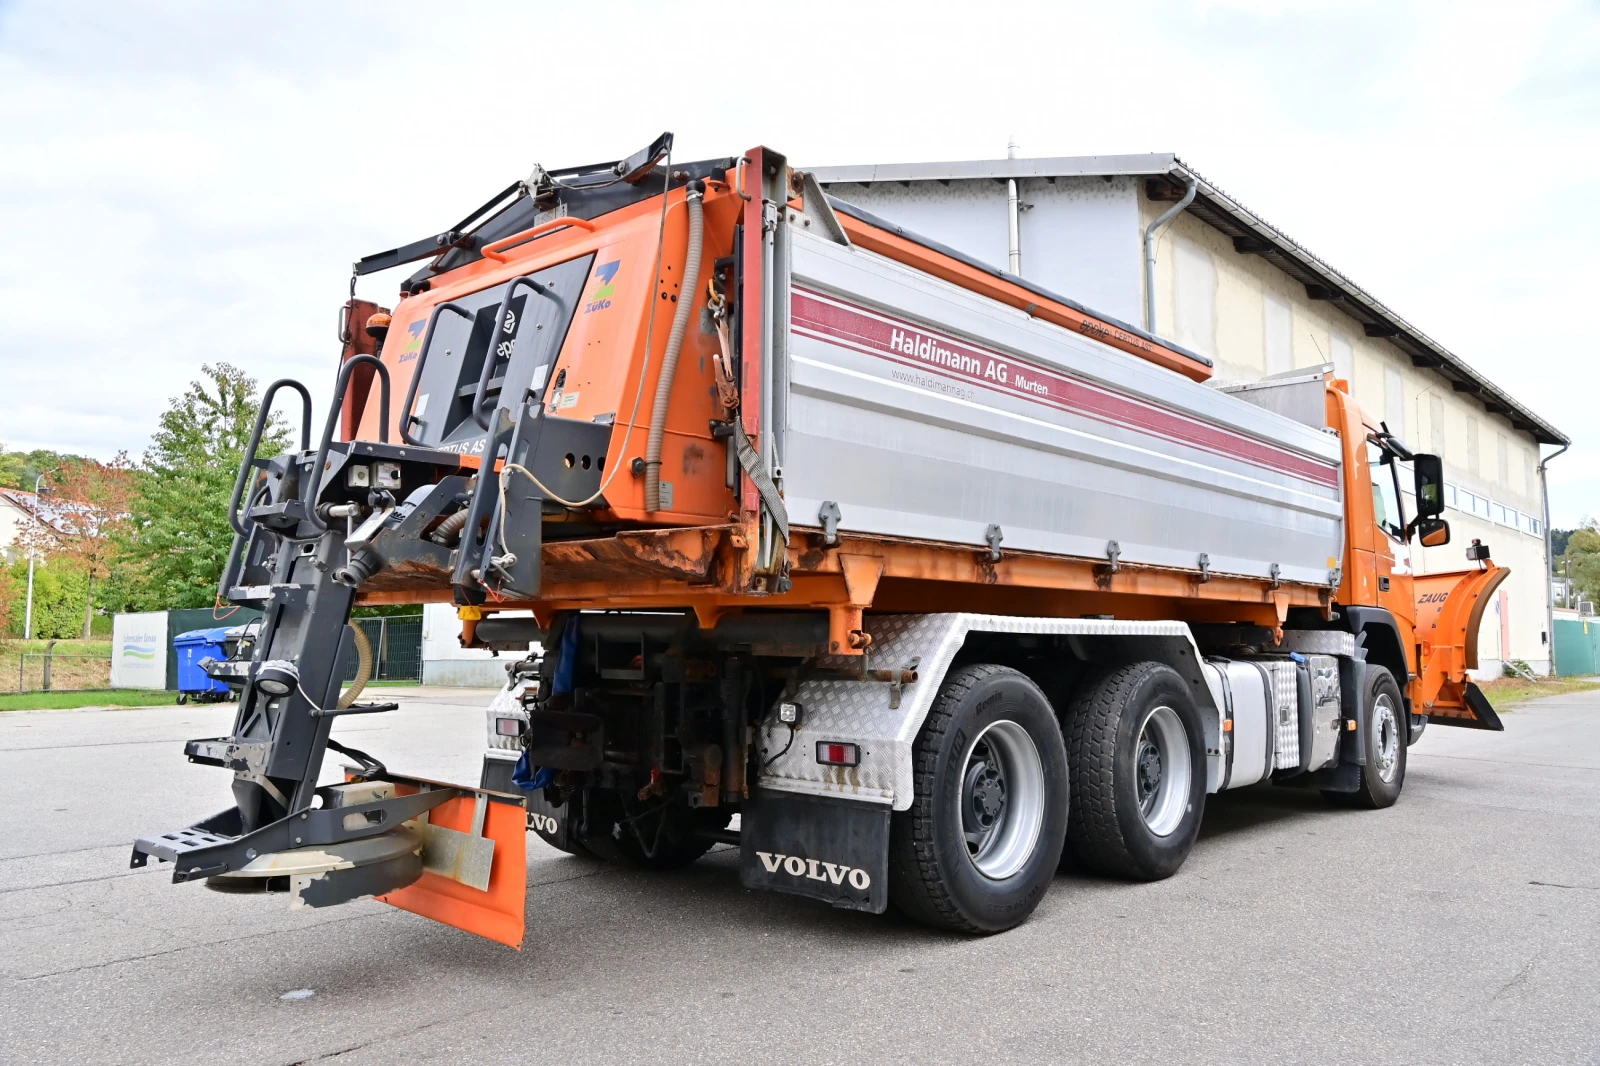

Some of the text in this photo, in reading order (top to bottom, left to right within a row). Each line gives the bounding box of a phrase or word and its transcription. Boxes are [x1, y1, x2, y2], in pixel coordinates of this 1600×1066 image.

[584, 298, 612, 314] ZüKo
[890, 328, 1048, 395] Haldimann AG Murten
[891, 369, 975, 399] www.haldimannag.ch
[470, 439, 486, 454] AS
[525, 811, 558, 834] LVO
[756, 851, 871, 890] VOLVO
